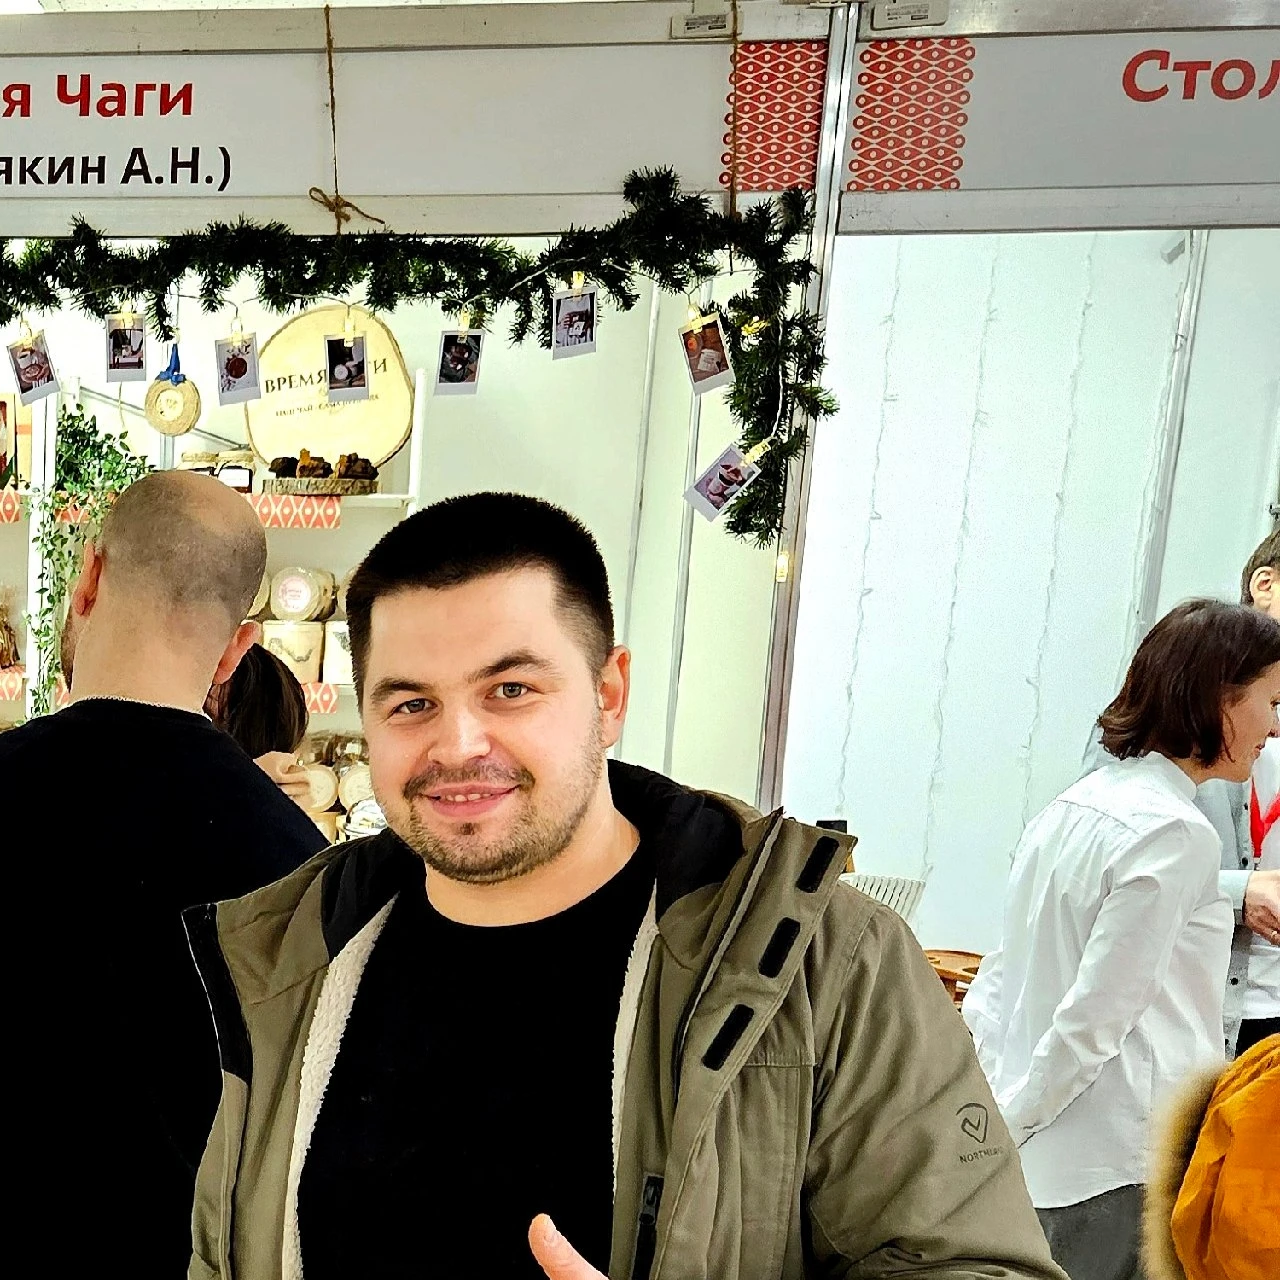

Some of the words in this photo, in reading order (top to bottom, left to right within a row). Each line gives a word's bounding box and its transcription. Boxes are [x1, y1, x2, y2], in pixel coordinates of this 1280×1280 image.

[56, 73, 193, 118] Чаги
[119, 145, 232, 192] А.Н.)
[264, 368, 327, 394] ВРЕМЯ
